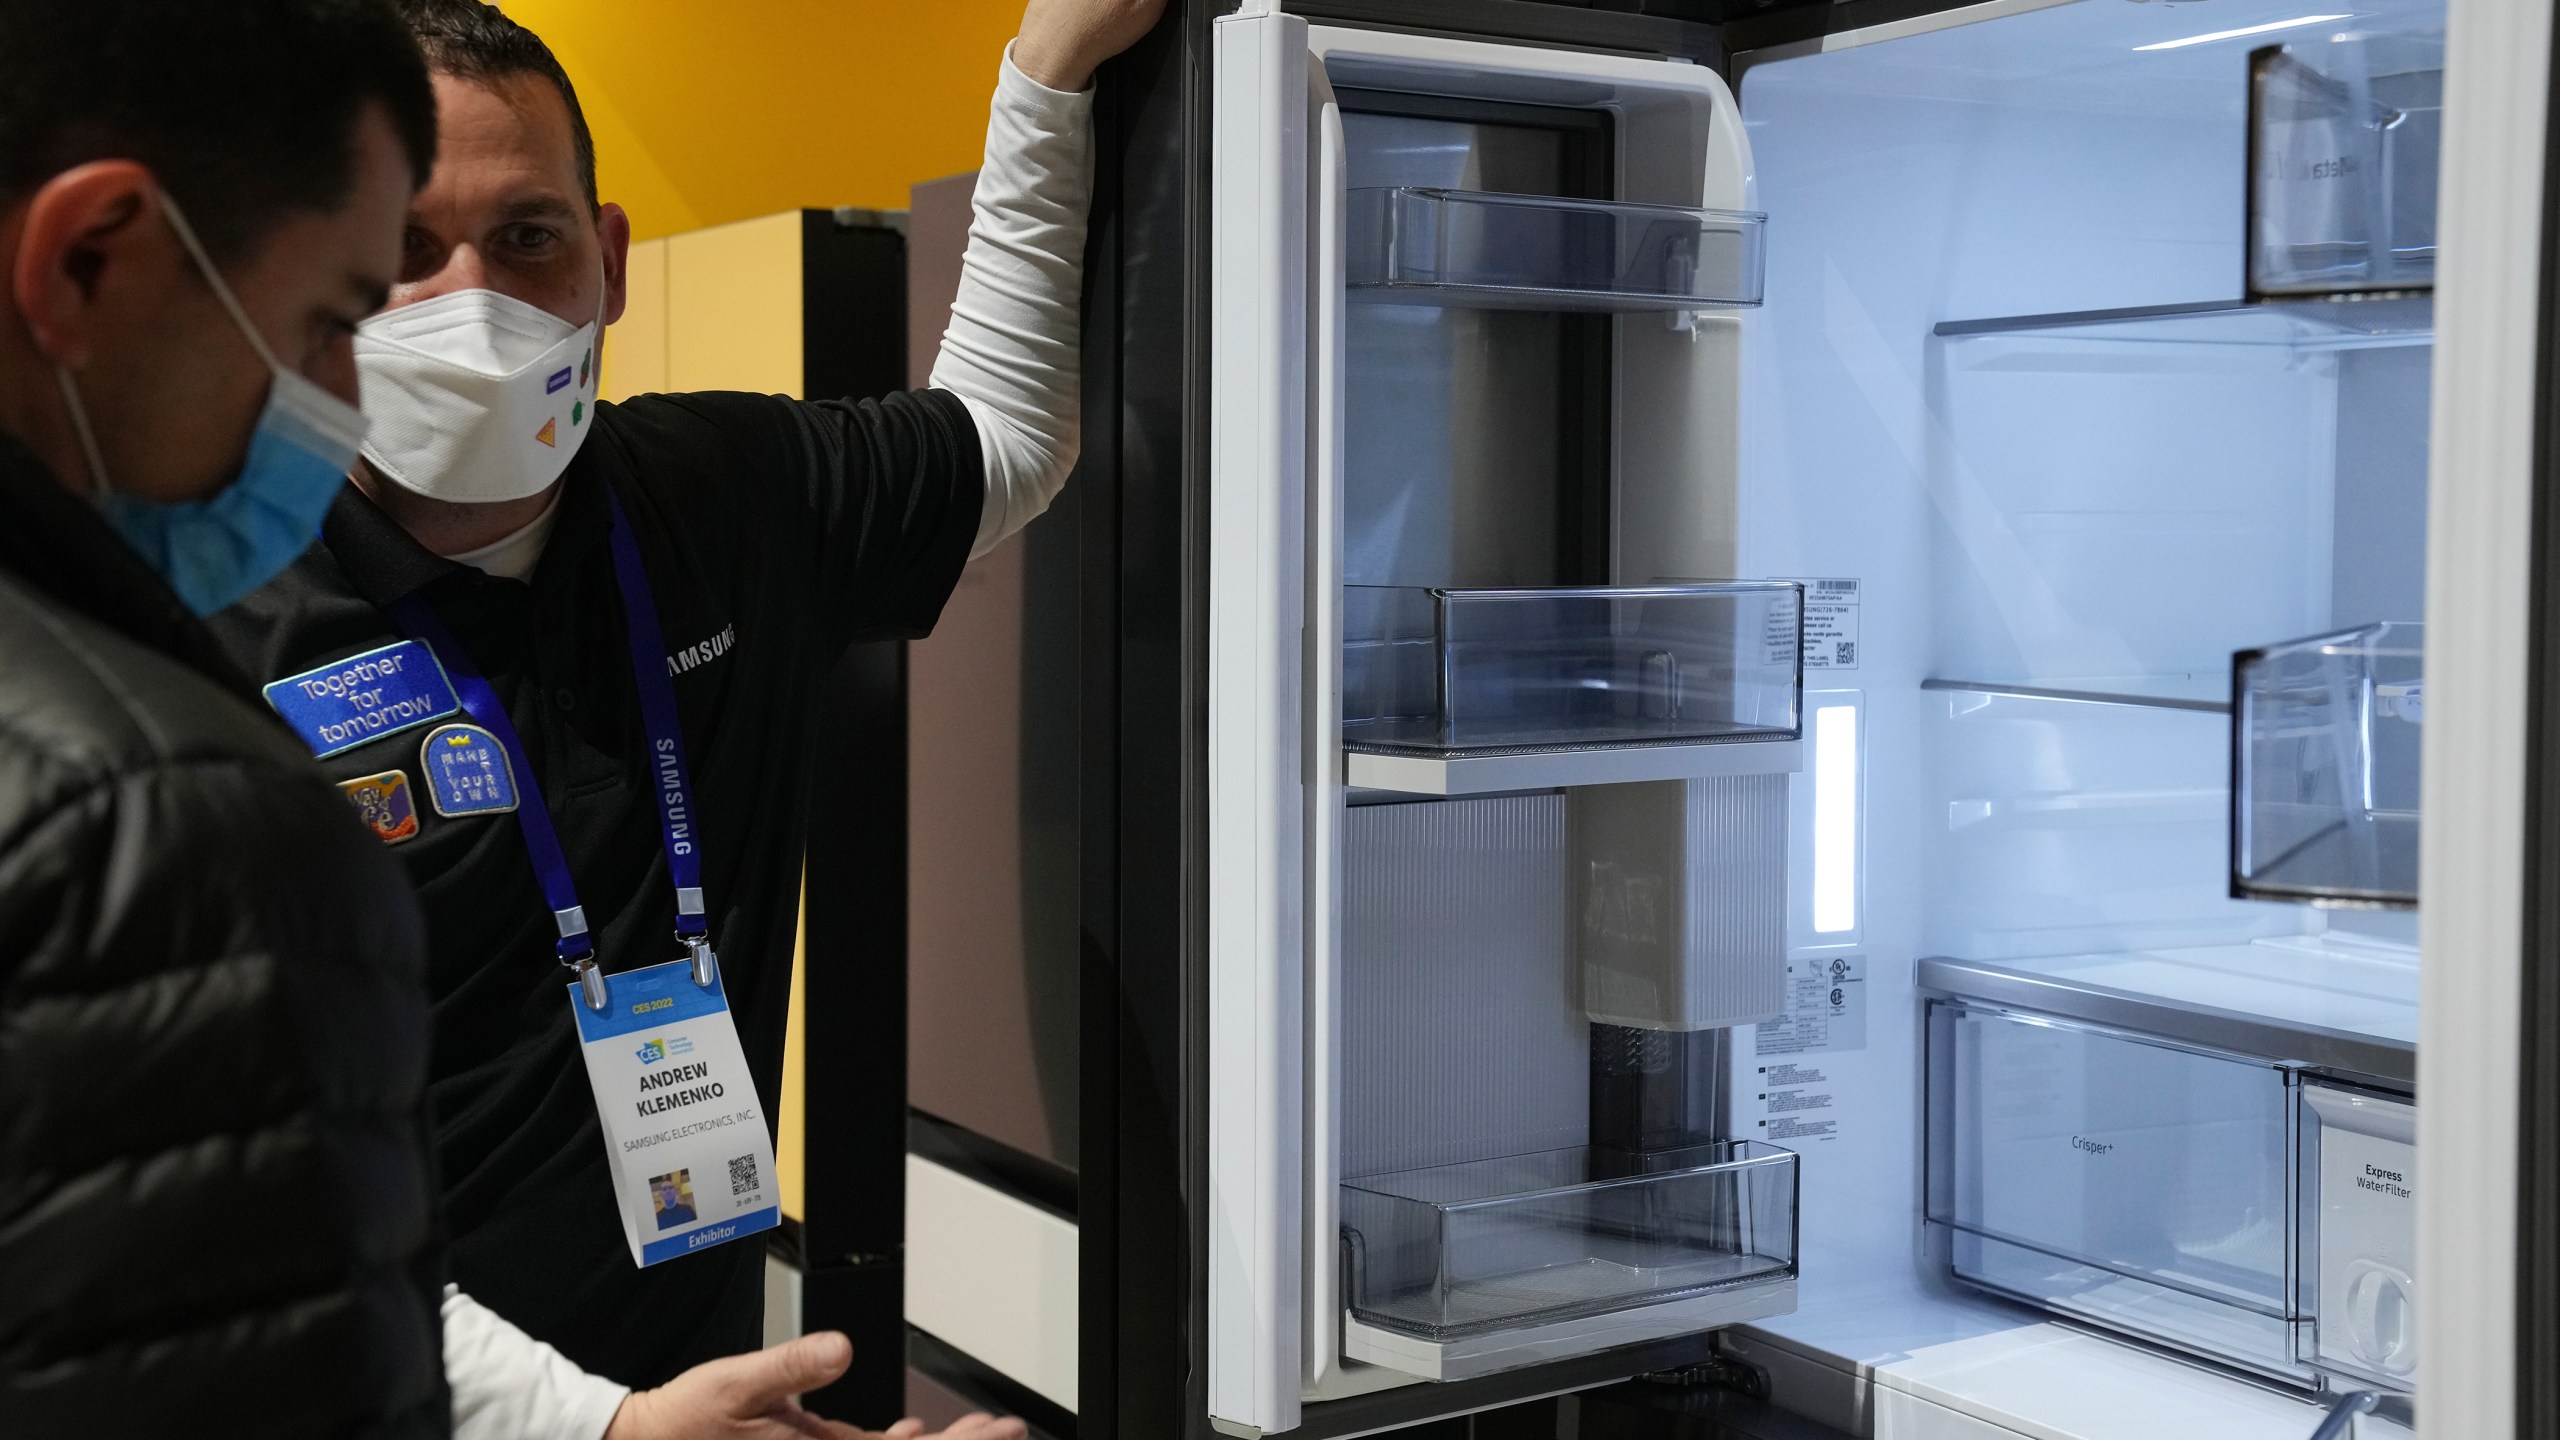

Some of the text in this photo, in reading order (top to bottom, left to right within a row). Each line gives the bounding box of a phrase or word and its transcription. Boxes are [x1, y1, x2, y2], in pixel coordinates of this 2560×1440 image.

[666, 623, 735, 677] AMSUNG
[297, 654, 403, 699] Together
[348, 687, 383, 711] for
[318, 693, 432, 744] tomorrow
[440, 749, 490, 765] MAKE
[449, 774, 496, 790] YOUR
[452, 787, 499, 803] OWN
[656, 738, 692, 856] SAMSUNG
[632, 997, 674, 1015] CES 2022
[640, 1046, 661, 1061] CES
[640, 1061, 708, 1092] ANDREW
[636, 1082, 724, 1117] KLEMENKO
[623, 1109, 756, 1152] SAMSUNG ELECTRONICS, INC.
[2072, 1135, 2113, 1155] Crisper+
[2365, 1163, 2402, 1182] Express
[688, 1225, 736, 1249] Exhibitor
